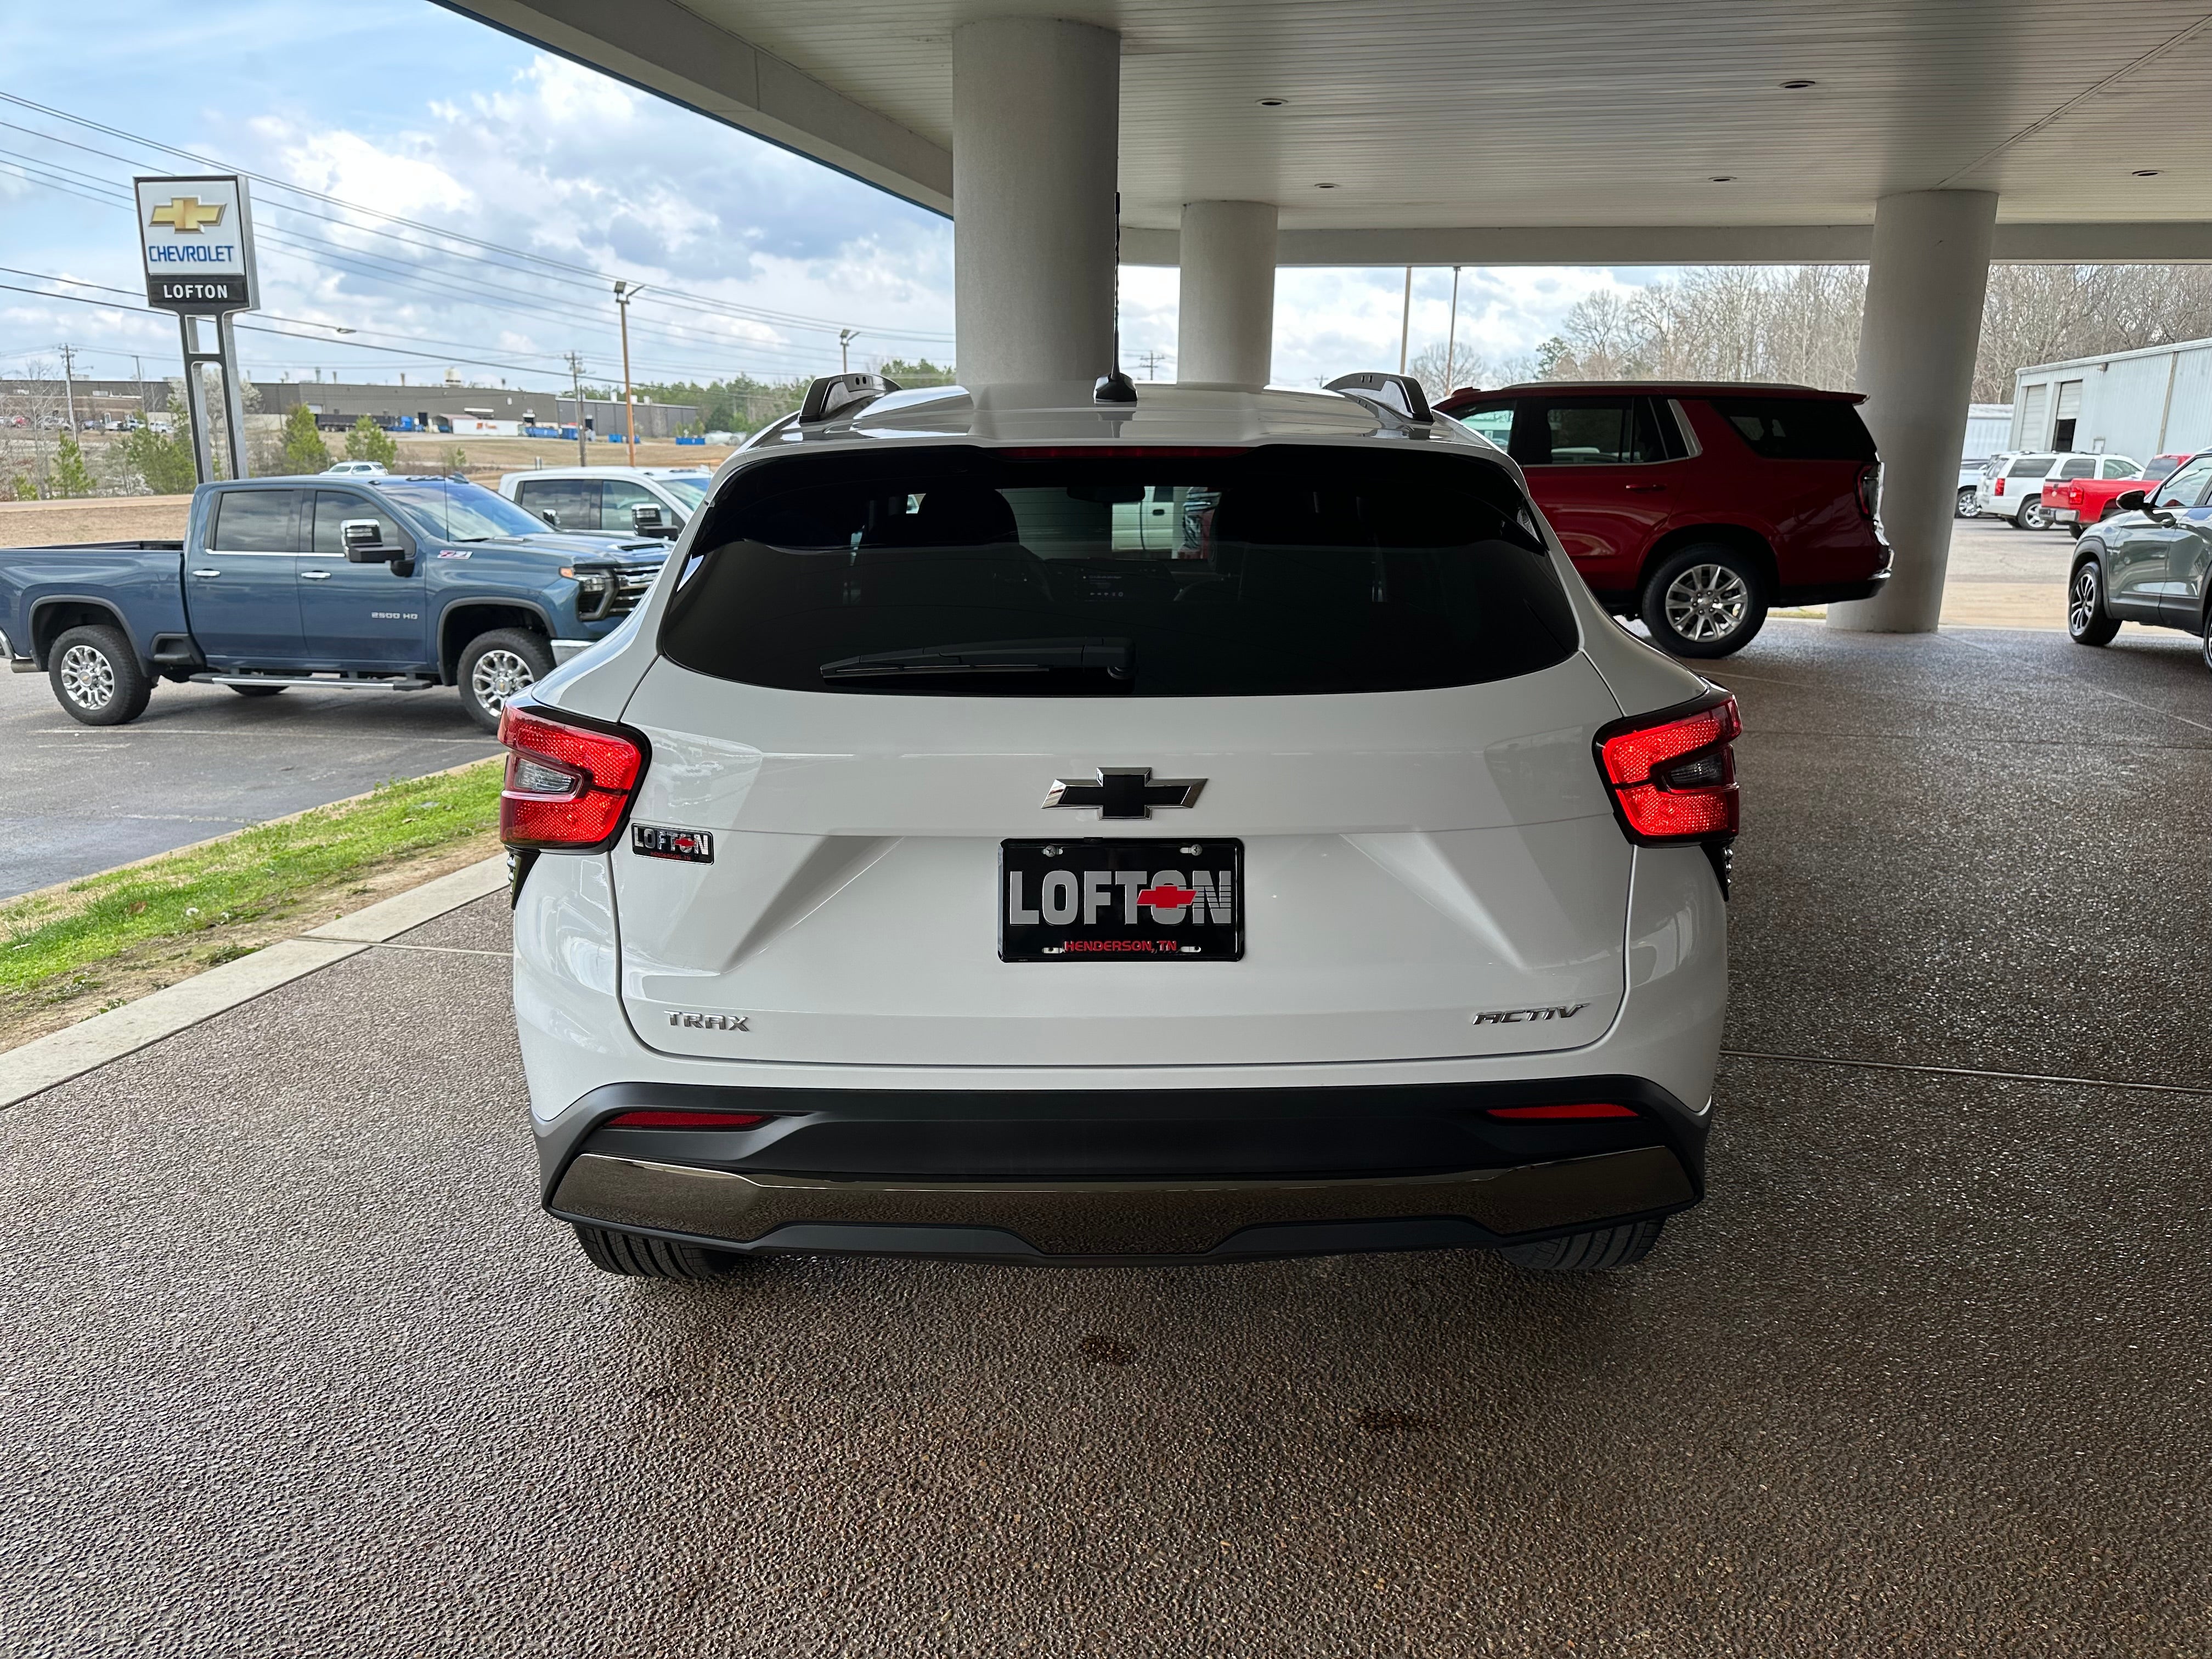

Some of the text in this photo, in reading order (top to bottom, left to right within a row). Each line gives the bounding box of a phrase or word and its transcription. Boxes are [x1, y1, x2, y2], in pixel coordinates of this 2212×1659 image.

[149, 245, 234, 262] CHEVROLET
[163, 285, 228, 298] LOFTON
[634, 827, 708, 855] LOFTON
[1010, 870, 1231, 925] LOFTON
[1064, 940, 1177, 953] HENDERSON, TN
[664, 1010, 749, 1031] TRAX
[1472, 1003, 1590, 1025] ACTIV
